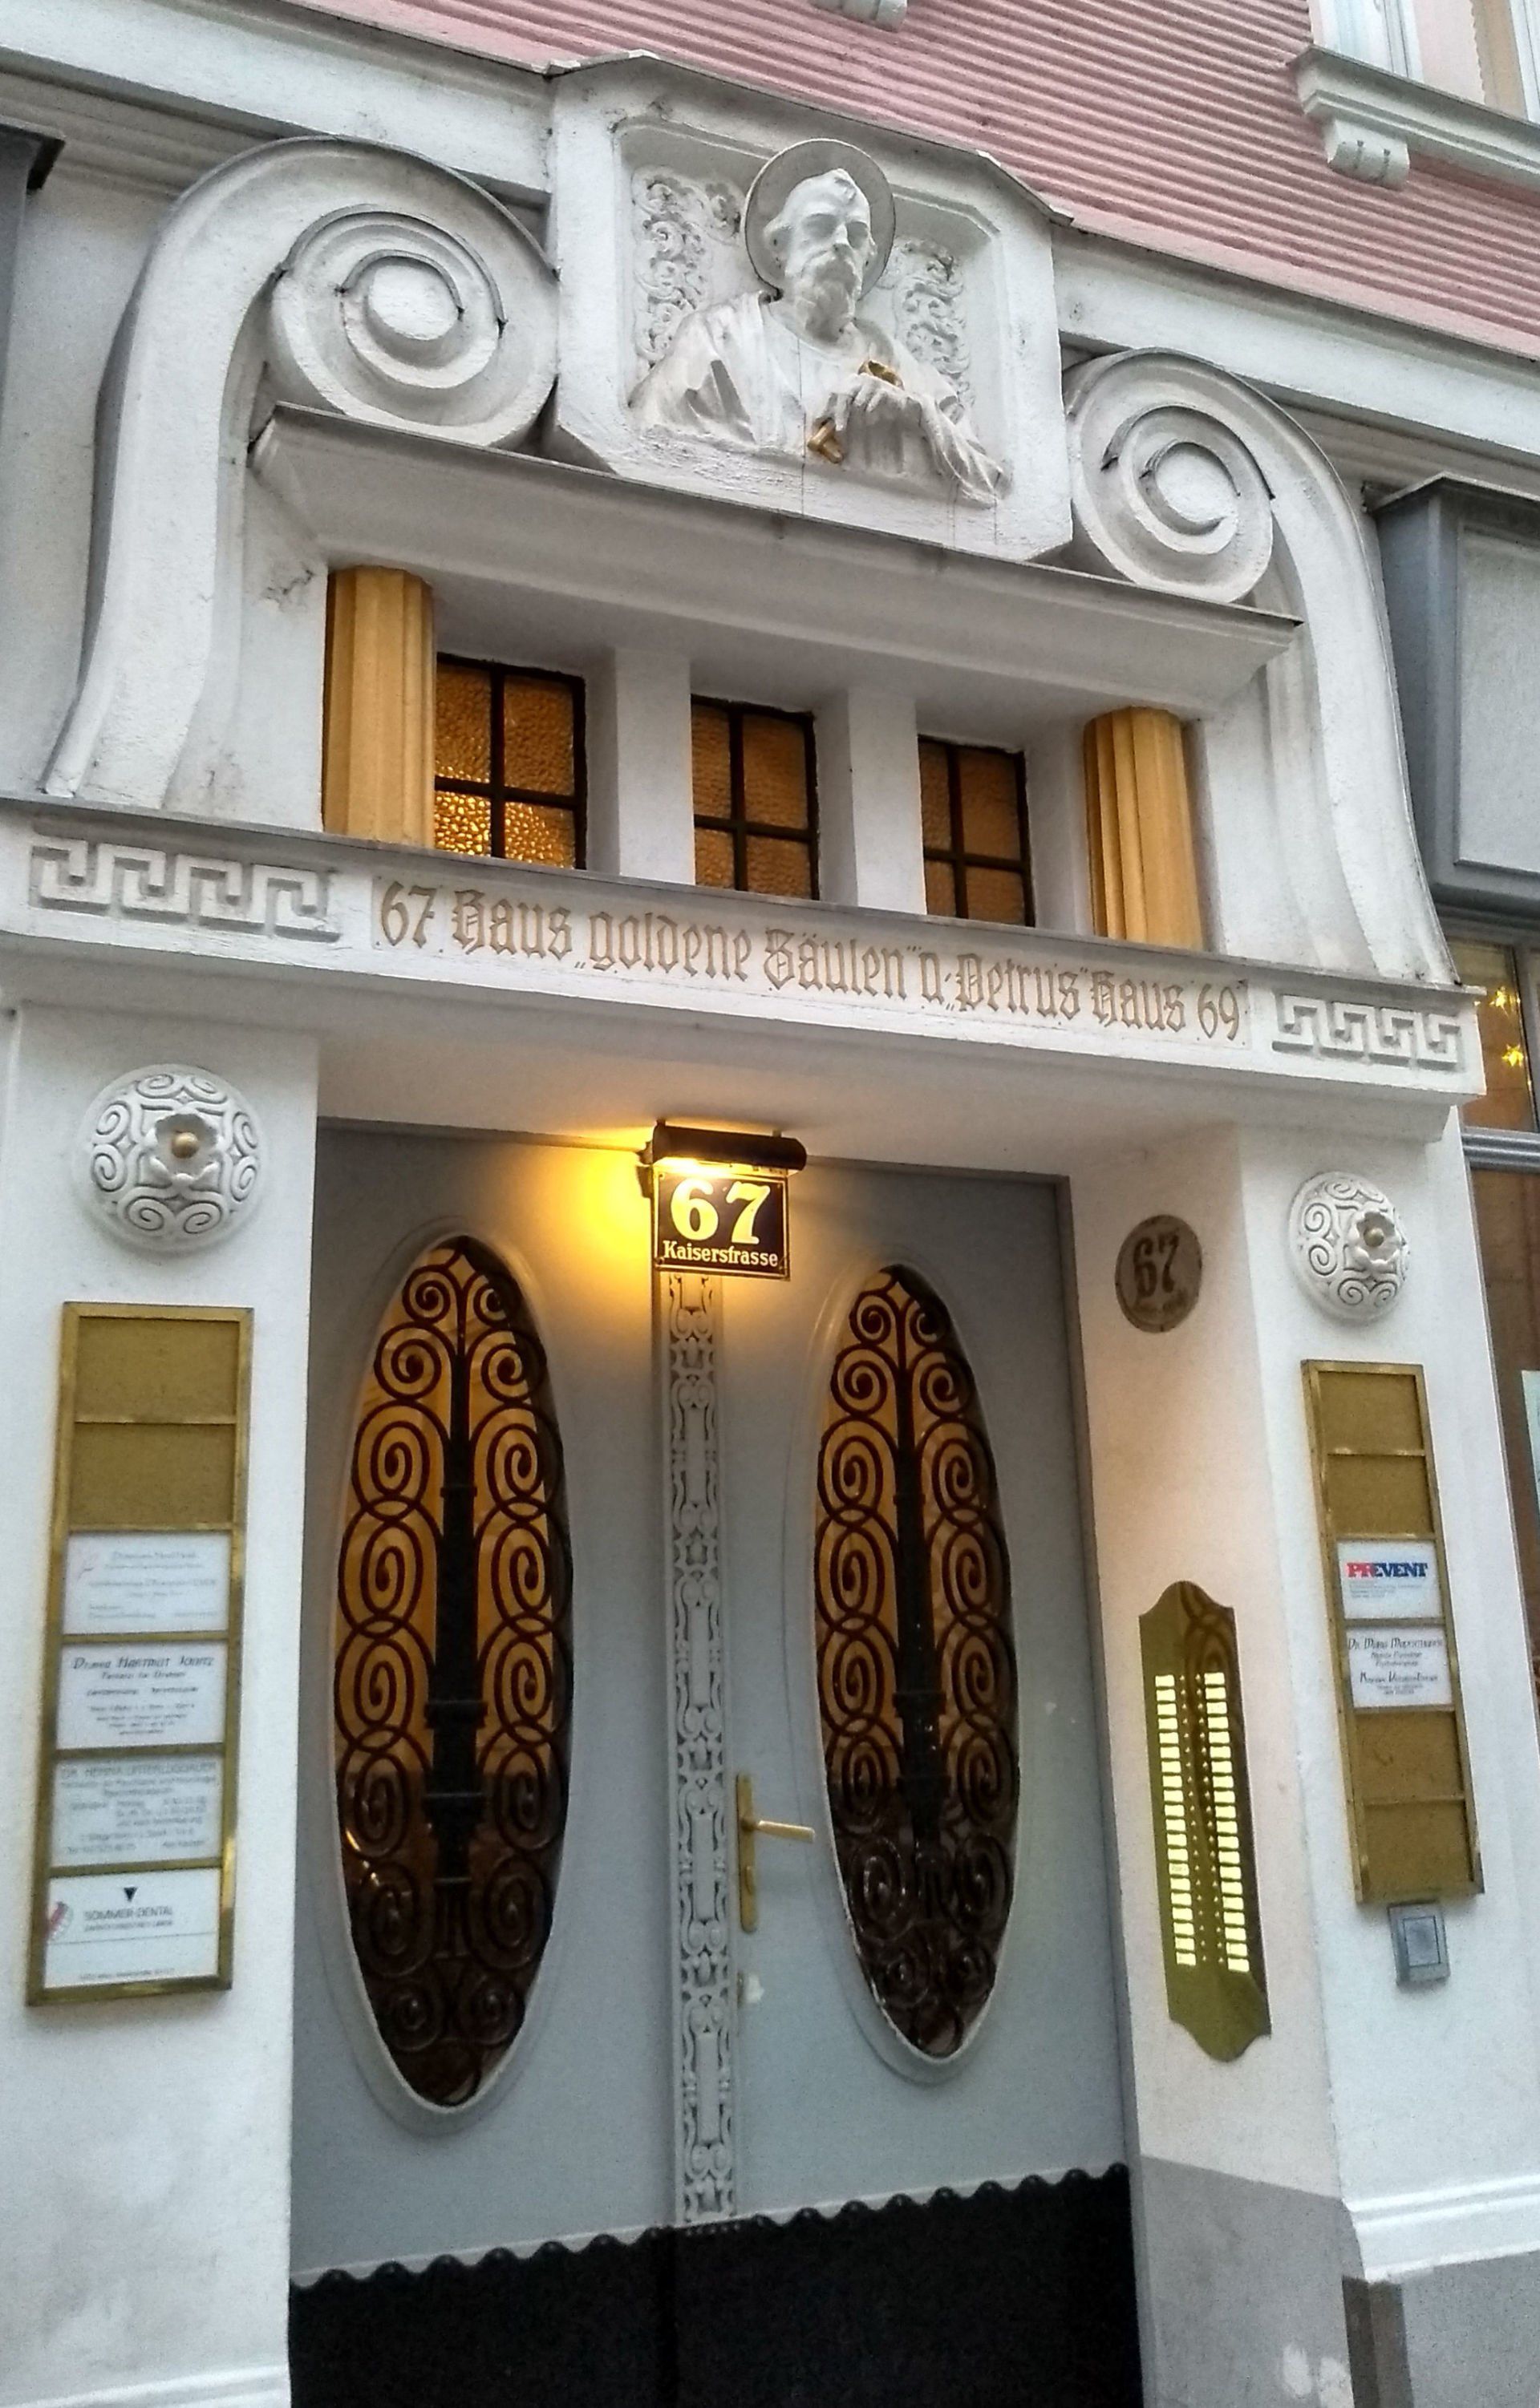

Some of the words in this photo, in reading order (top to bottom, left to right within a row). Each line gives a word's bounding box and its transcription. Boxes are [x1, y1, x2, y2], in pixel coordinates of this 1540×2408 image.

[381, 880, 438, 949] 67
[451, 888, 573, 961] Haus
[1089, 969, 1187, 1033] Haus
[1197, 982, 1241, 1042] 69
[670, 1177, 772, 1245] 67
[662, 1240, 779, 1268] Kaiserstrasse
[1132, 1232, 1181, 1298] 67
[1346, 1561, 1429, 1578] PREVENT
